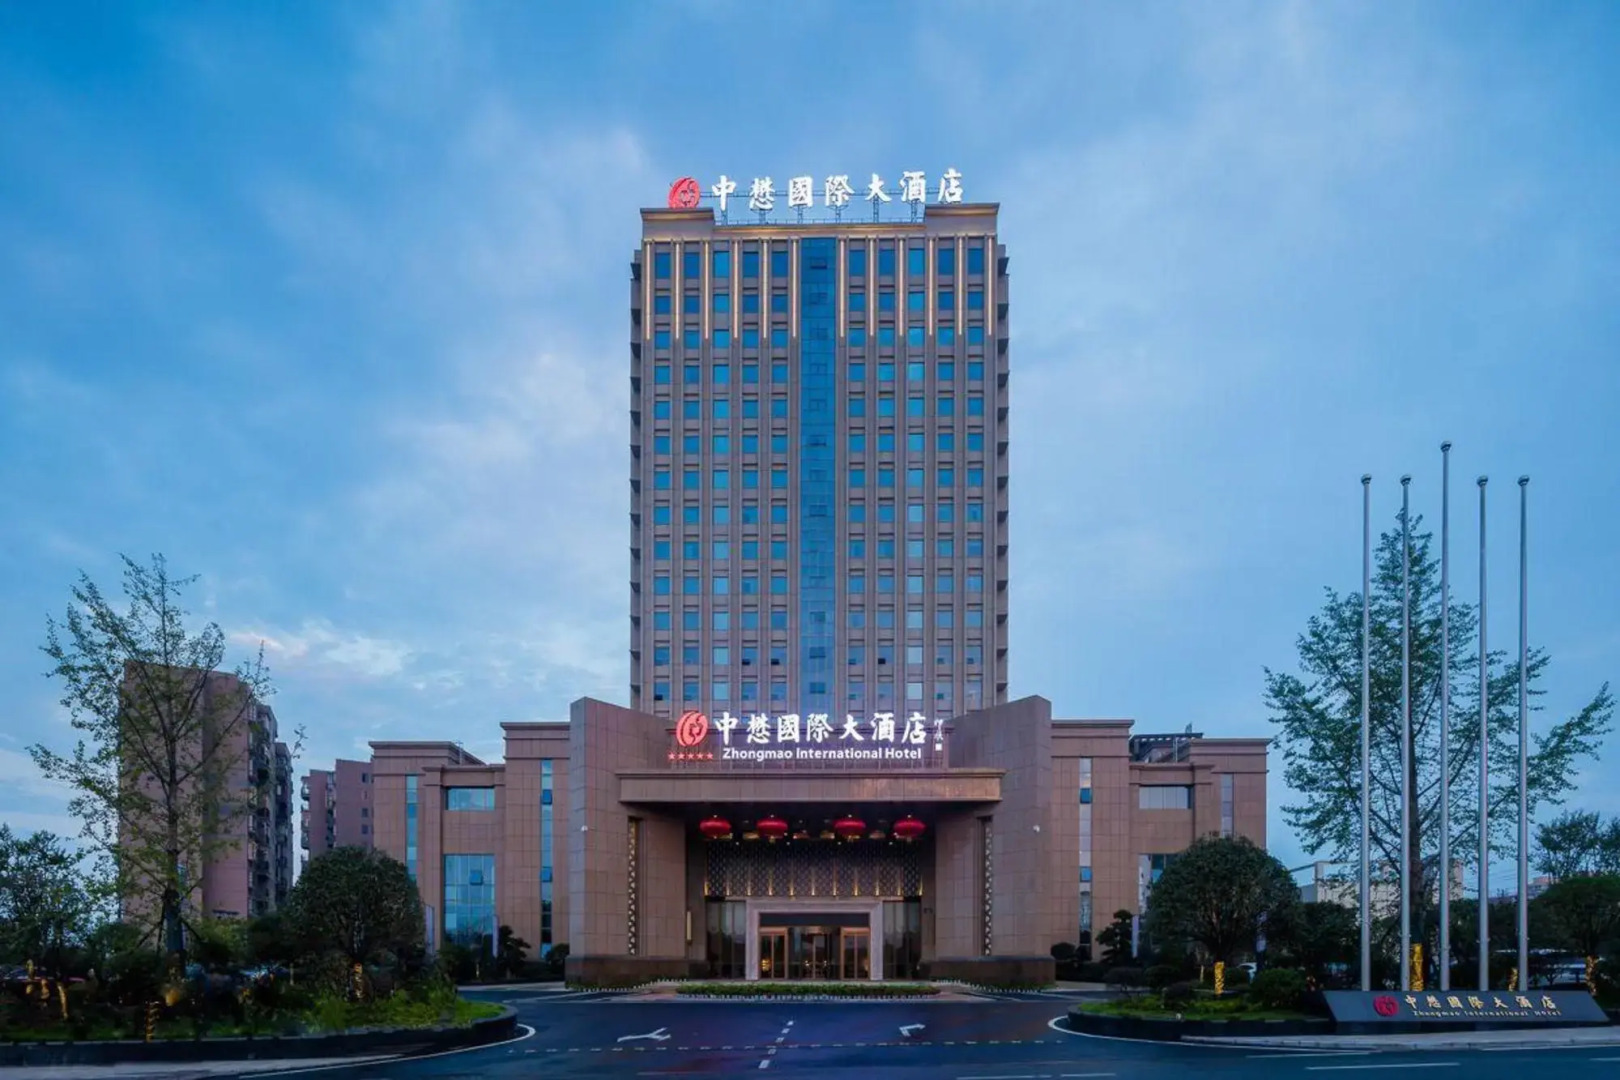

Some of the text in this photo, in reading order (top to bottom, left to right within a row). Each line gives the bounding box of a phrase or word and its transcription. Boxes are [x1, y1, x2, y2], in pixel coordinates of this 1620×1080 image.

[711, 168, 963, 210] 中懋國際大酒店
[714, 711, 927, 746] 中懋國際大酒店
[722, 747, 922, 762] Zhongmao International Hotel
